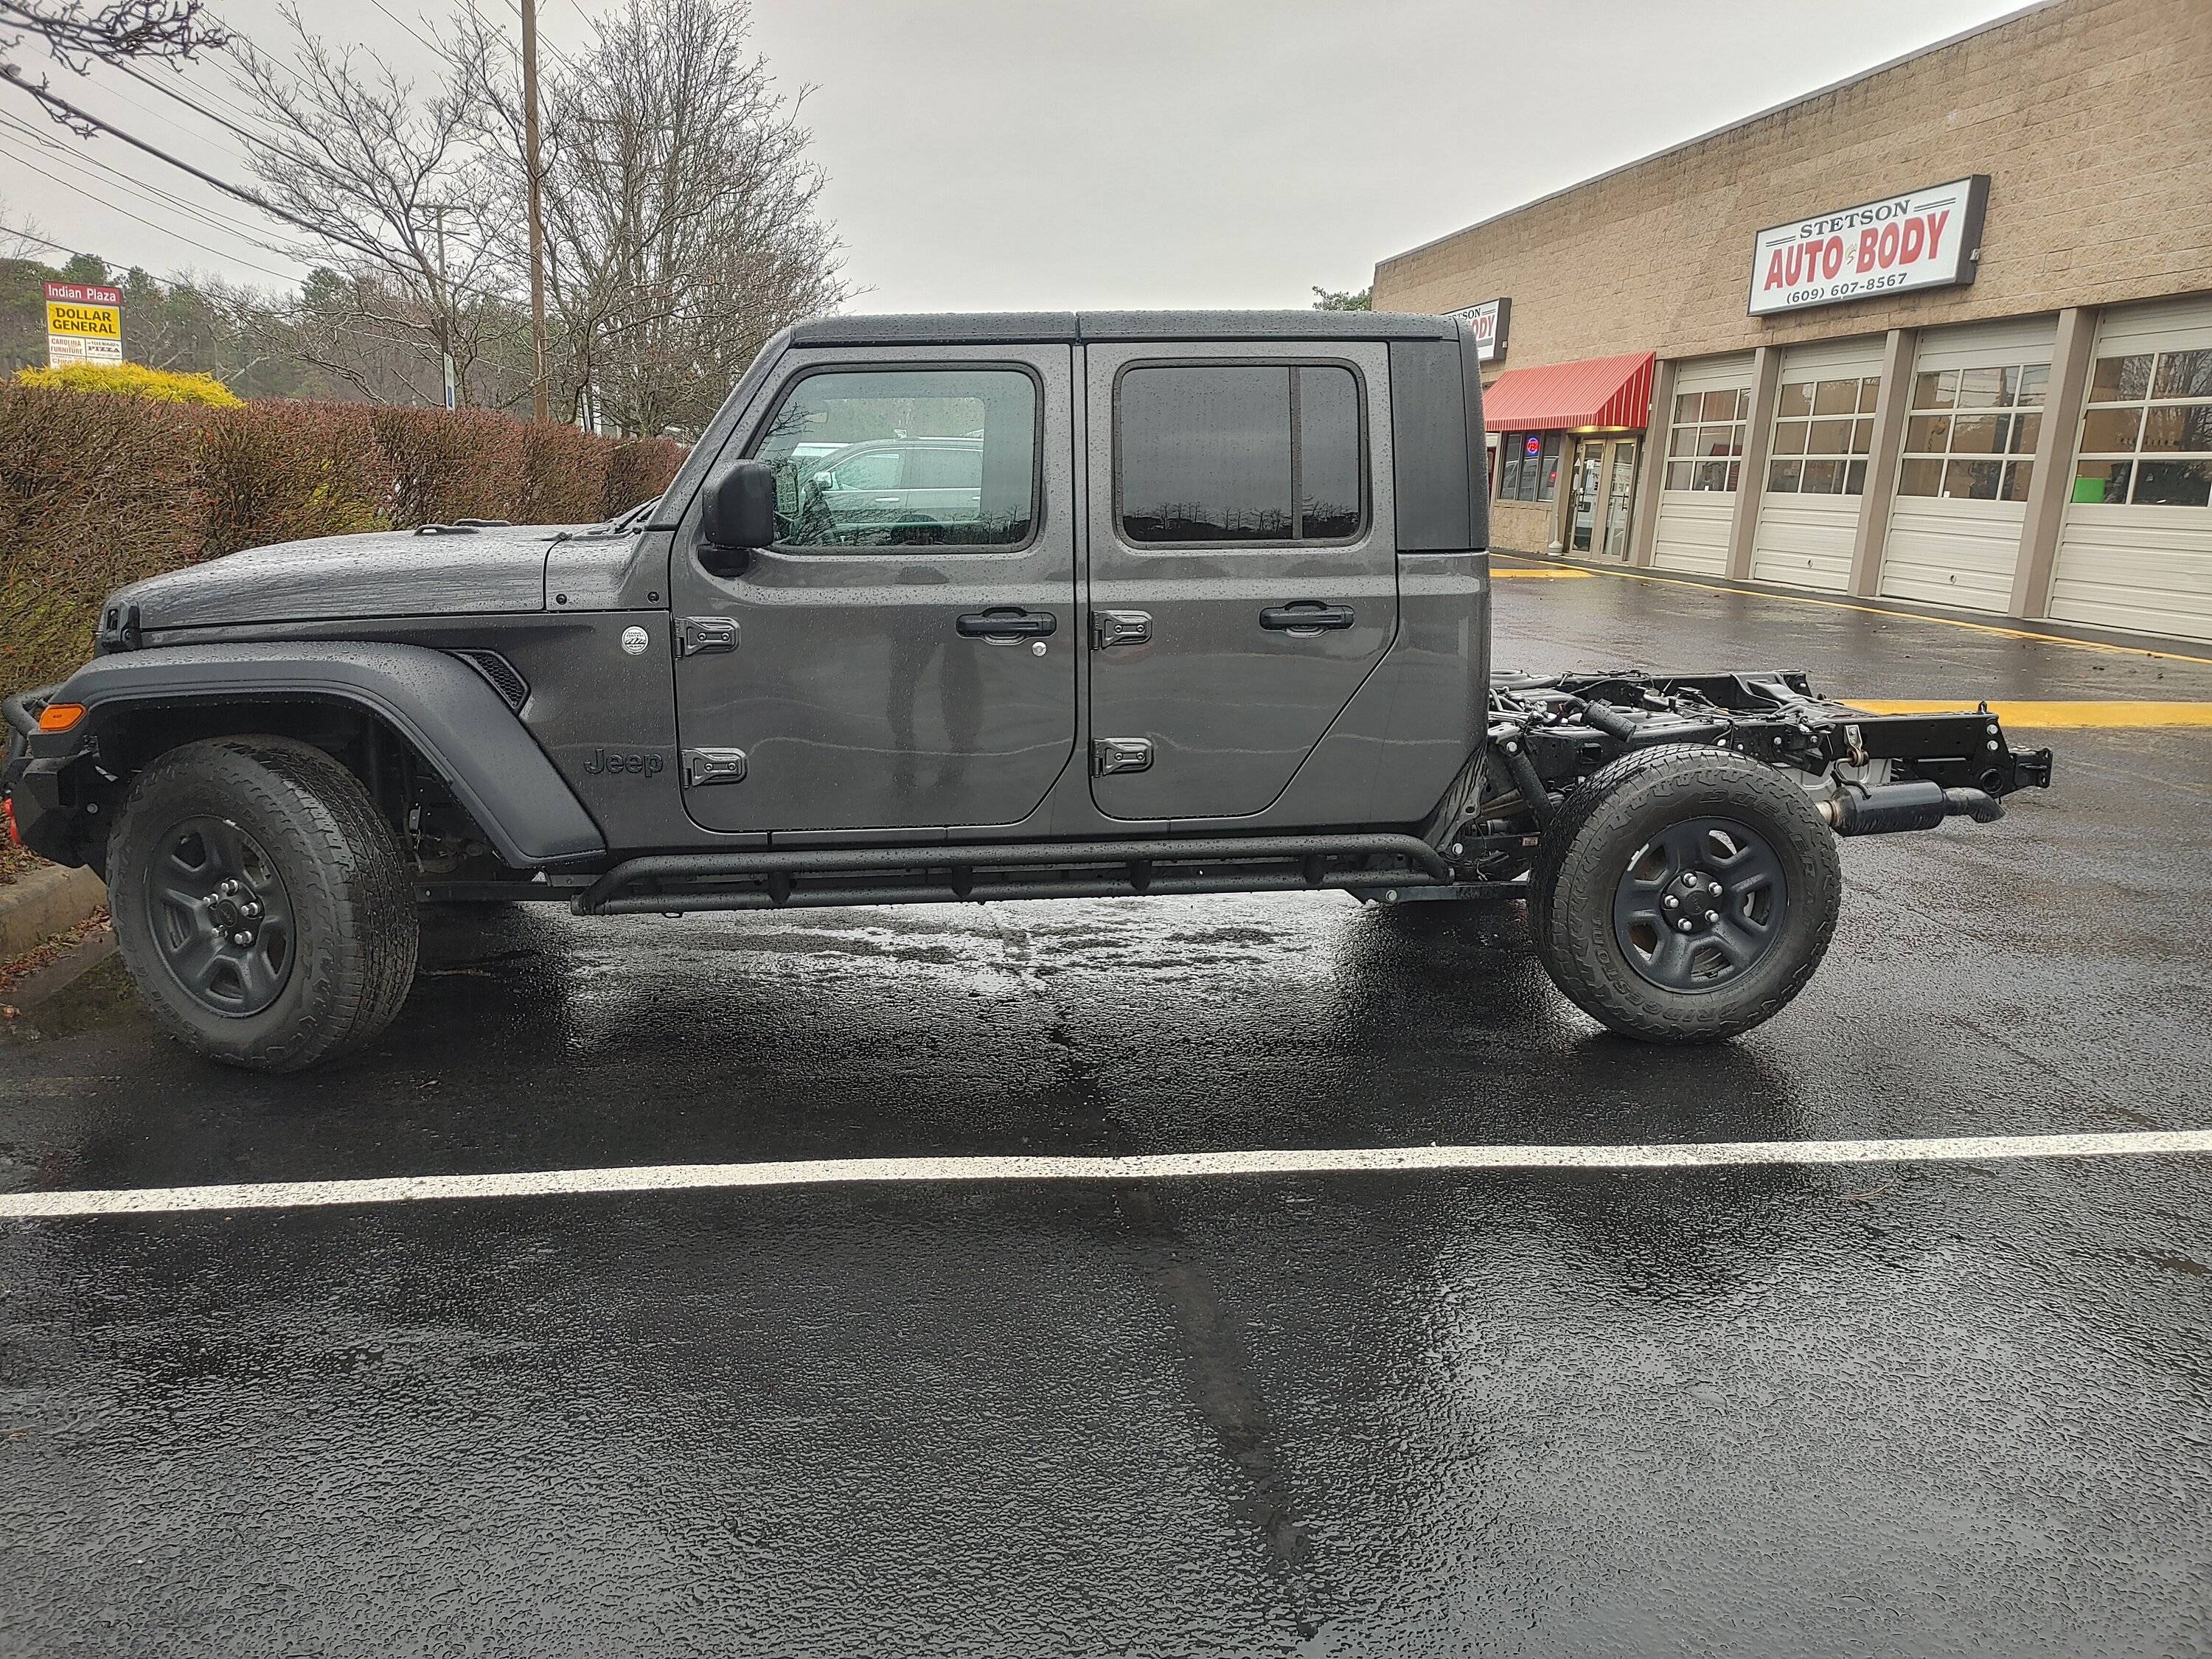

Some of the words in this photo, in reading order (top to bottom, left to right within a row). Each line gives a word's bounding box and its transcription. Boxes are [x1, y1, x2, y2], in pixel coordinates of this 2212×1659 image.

[1800, 199, 1910, 239] STETSON
[1764, 235, 1843, 291] AUTO
[1856, 209, 1950, 274] BODY
[48, 284, 82, 299] Indian
[87, 288, 116, 302] Plaza
[1787, 288, 1825, 305] (609)
[1831, 272, 1907, 296] 607-8567
[55, 307, 112, 322] DOLLAR
[52, 319, 116, 334] GENERAL
[1472, 314, 1495, 339] ODY
[50, 346, 83, 355] FURNITURE
[51, 338, 81, 347] CAROLINA
[87, 345, 120, 353] PIZZA
[583, 748, 664, 778] Jeep
